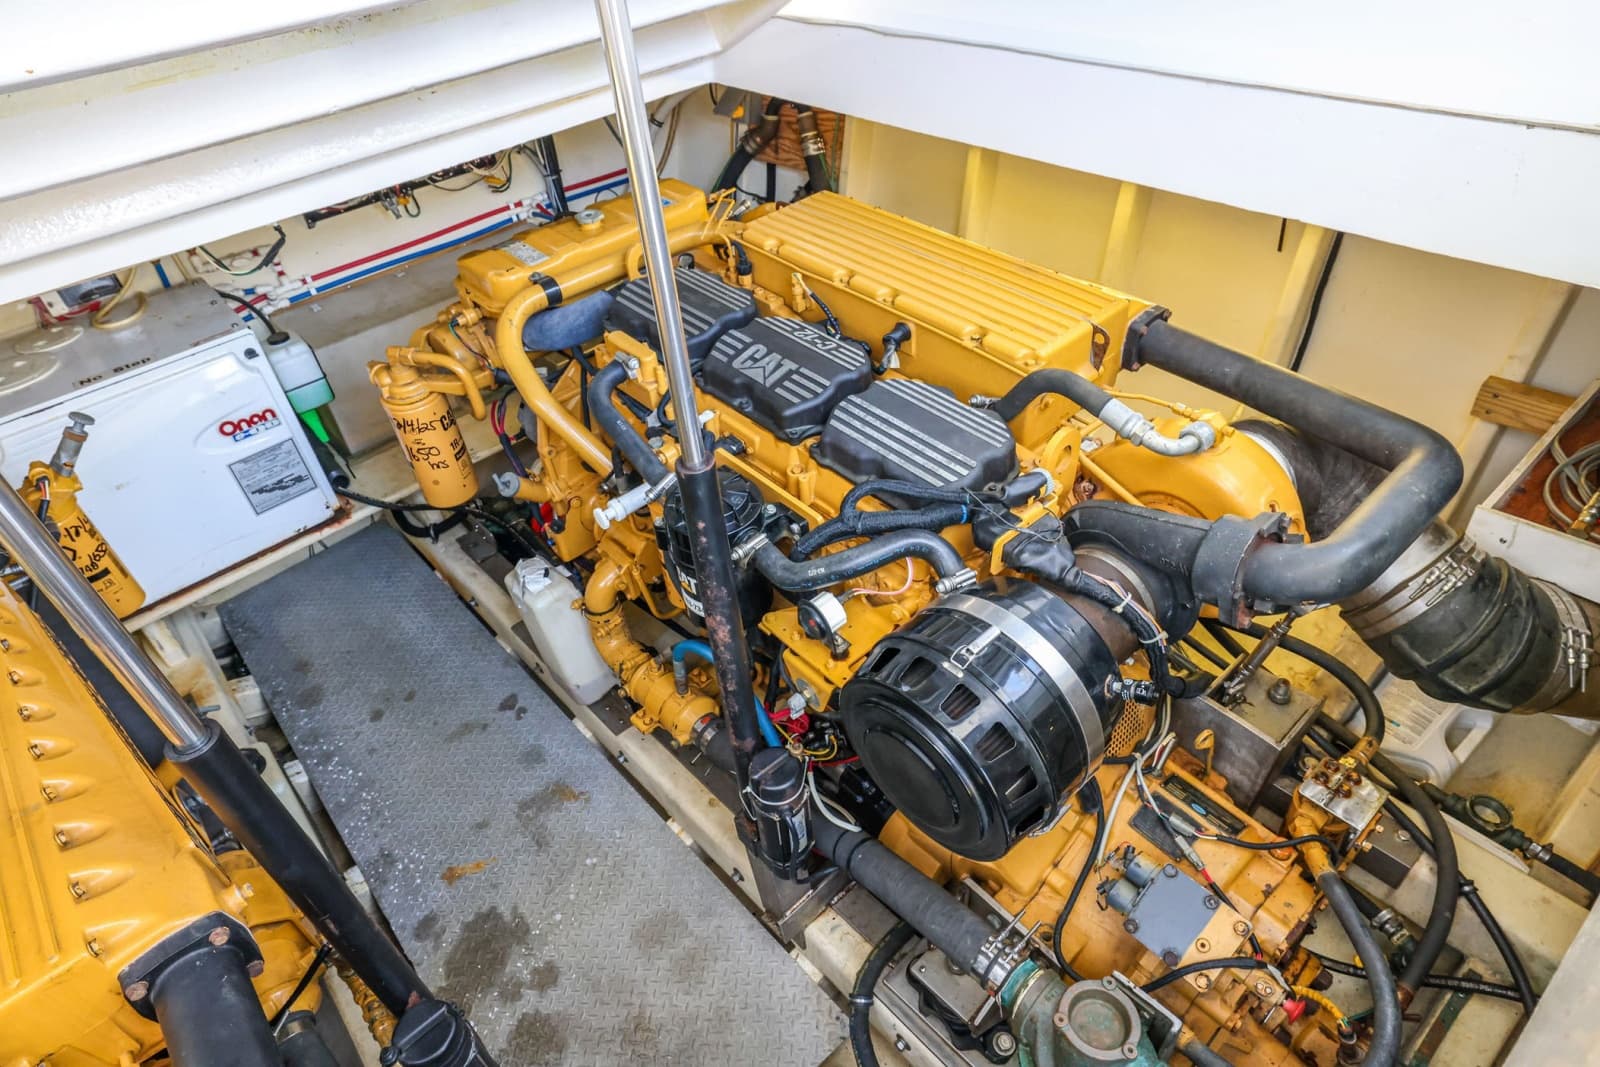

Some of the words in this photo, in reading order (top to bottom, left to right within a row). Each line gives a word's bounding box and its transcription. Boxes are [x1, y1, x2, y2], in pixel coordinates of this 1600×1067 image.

[794, 329, 838, 350] C-12
[79, 375, 103, 386] No
[113, 357, 151, 374] Step
[731, 343, 799, 388] CAT
[218, 408, 277, 437] Onan
